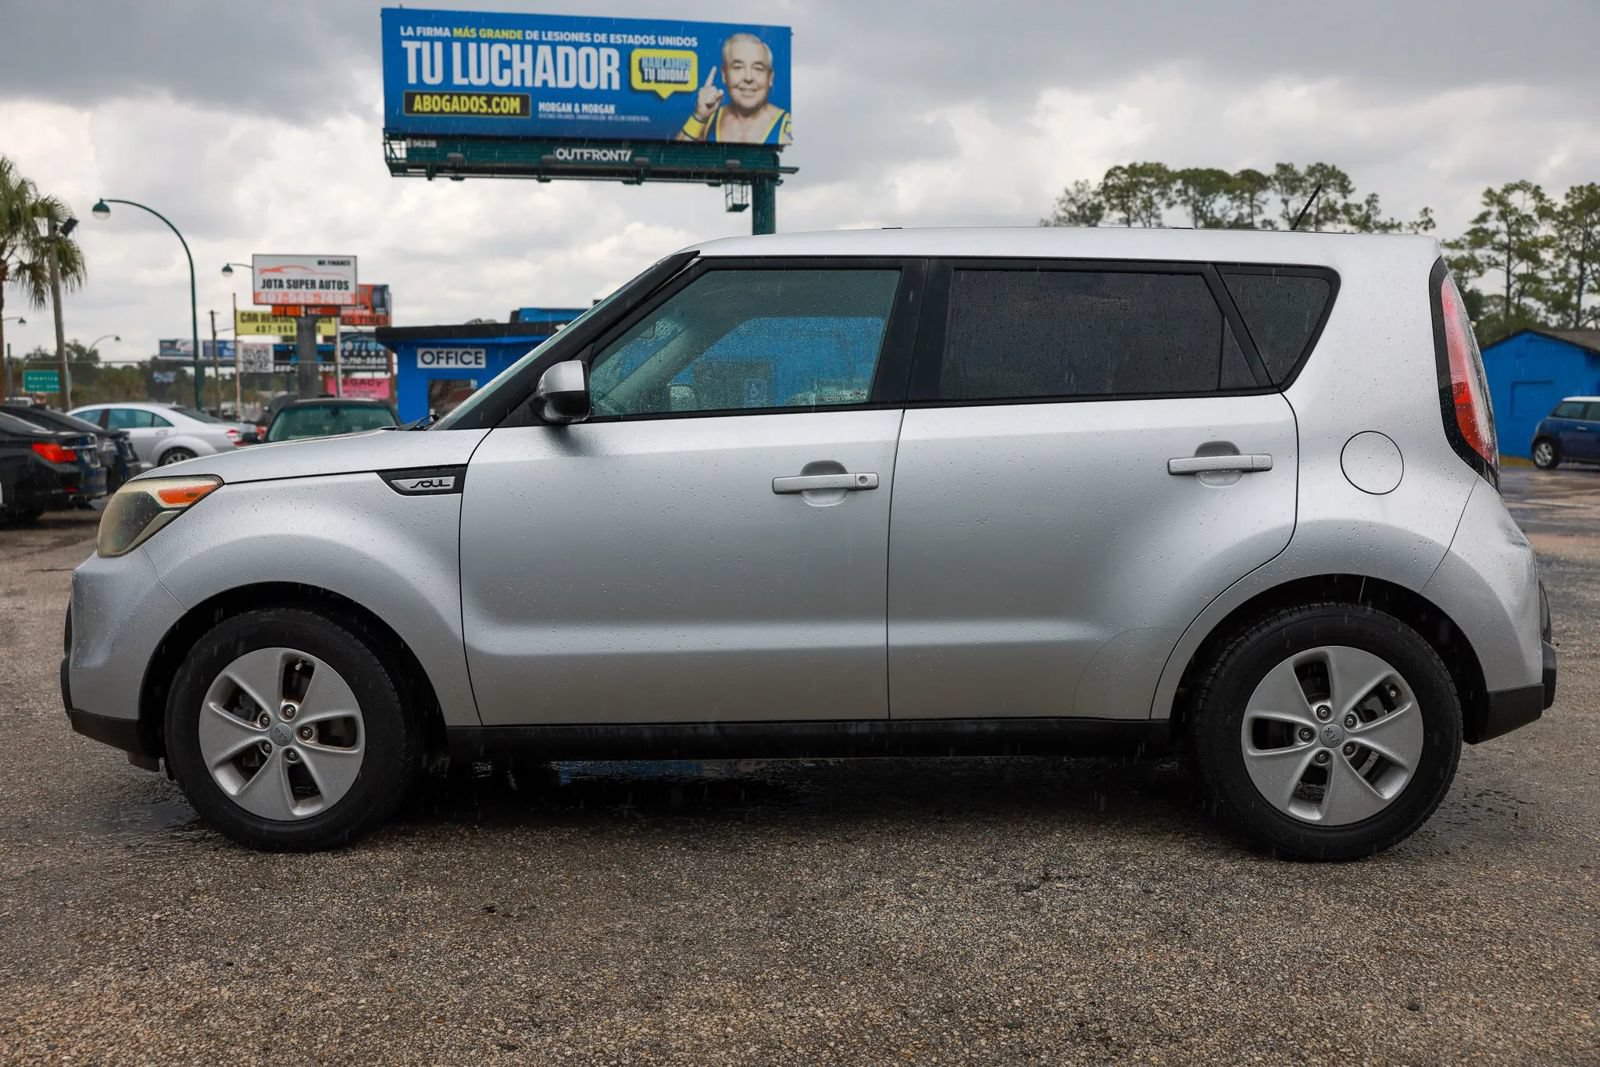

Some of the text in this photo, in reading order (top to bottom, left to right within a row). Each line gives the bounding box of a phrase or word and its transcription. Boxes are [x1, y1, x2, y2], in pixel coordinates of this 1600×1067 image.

[400, 26, 698, 47] LA FIRMA MÁS GRANDE DE LESIONES DE ESTADOS UNIDOS
[402, 41, 620, 91] TU LUCHADOR
[413, 95, 520, 114] ABOGADOS.COM
[538, 102, 572, 113] MORGAN
[582, 103, 615, 114] MORGAN
[261, 279, 349, 290] JOTA SUPER AUTOS
[240, 312, 258, 323] CAR
[421, 351, 483, 365] OFFICE
[410, 480, 450, 489] SOUL
